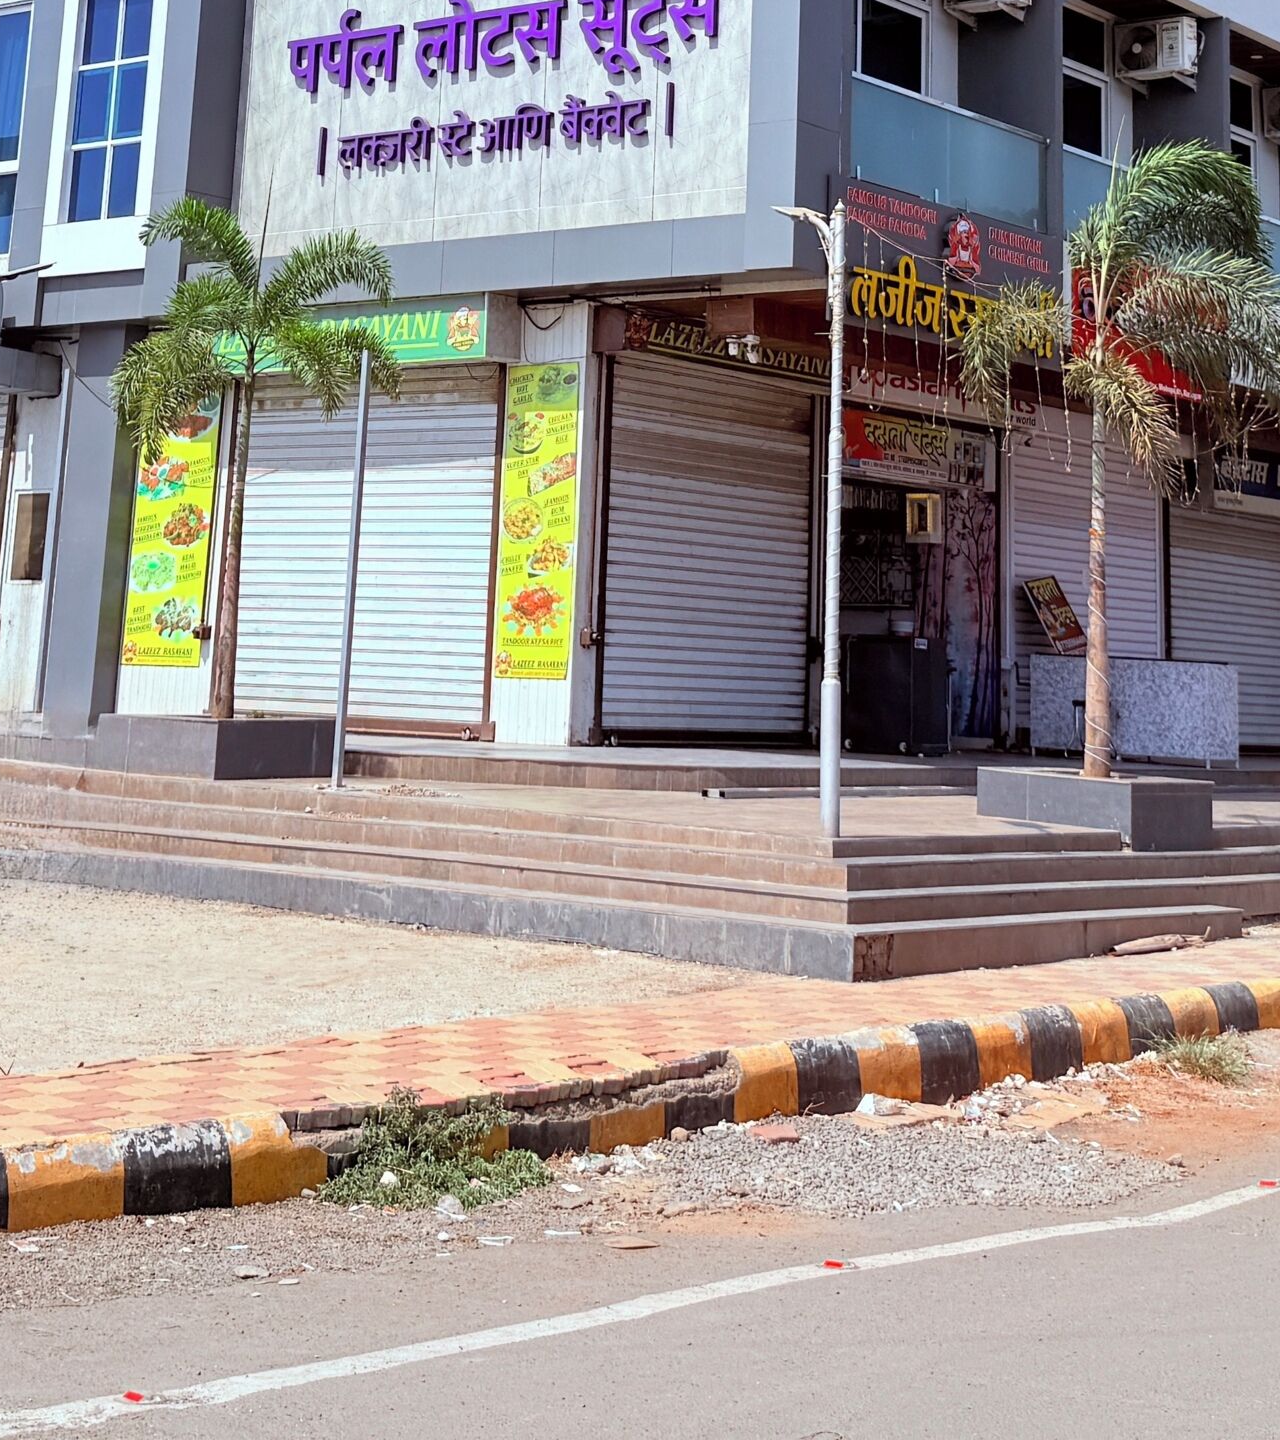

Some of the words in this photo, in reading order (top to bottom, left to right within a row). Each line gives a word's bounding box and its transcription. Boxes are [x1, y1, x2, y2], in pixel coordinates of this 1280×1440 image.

[287, 9, 404, 94] पर्पल
[437, 110, 476, 157] स्टे
[478, 103, 554, 153] आणि
[846, 206, 887, 229] FAMOUS
[888, 216, 928, 241] PAKODA
[847, 186, 887, 209] FAMOUS
[889, 197, 937, 225] TANDOORI
[851, 255, 947, 334] लजीज
